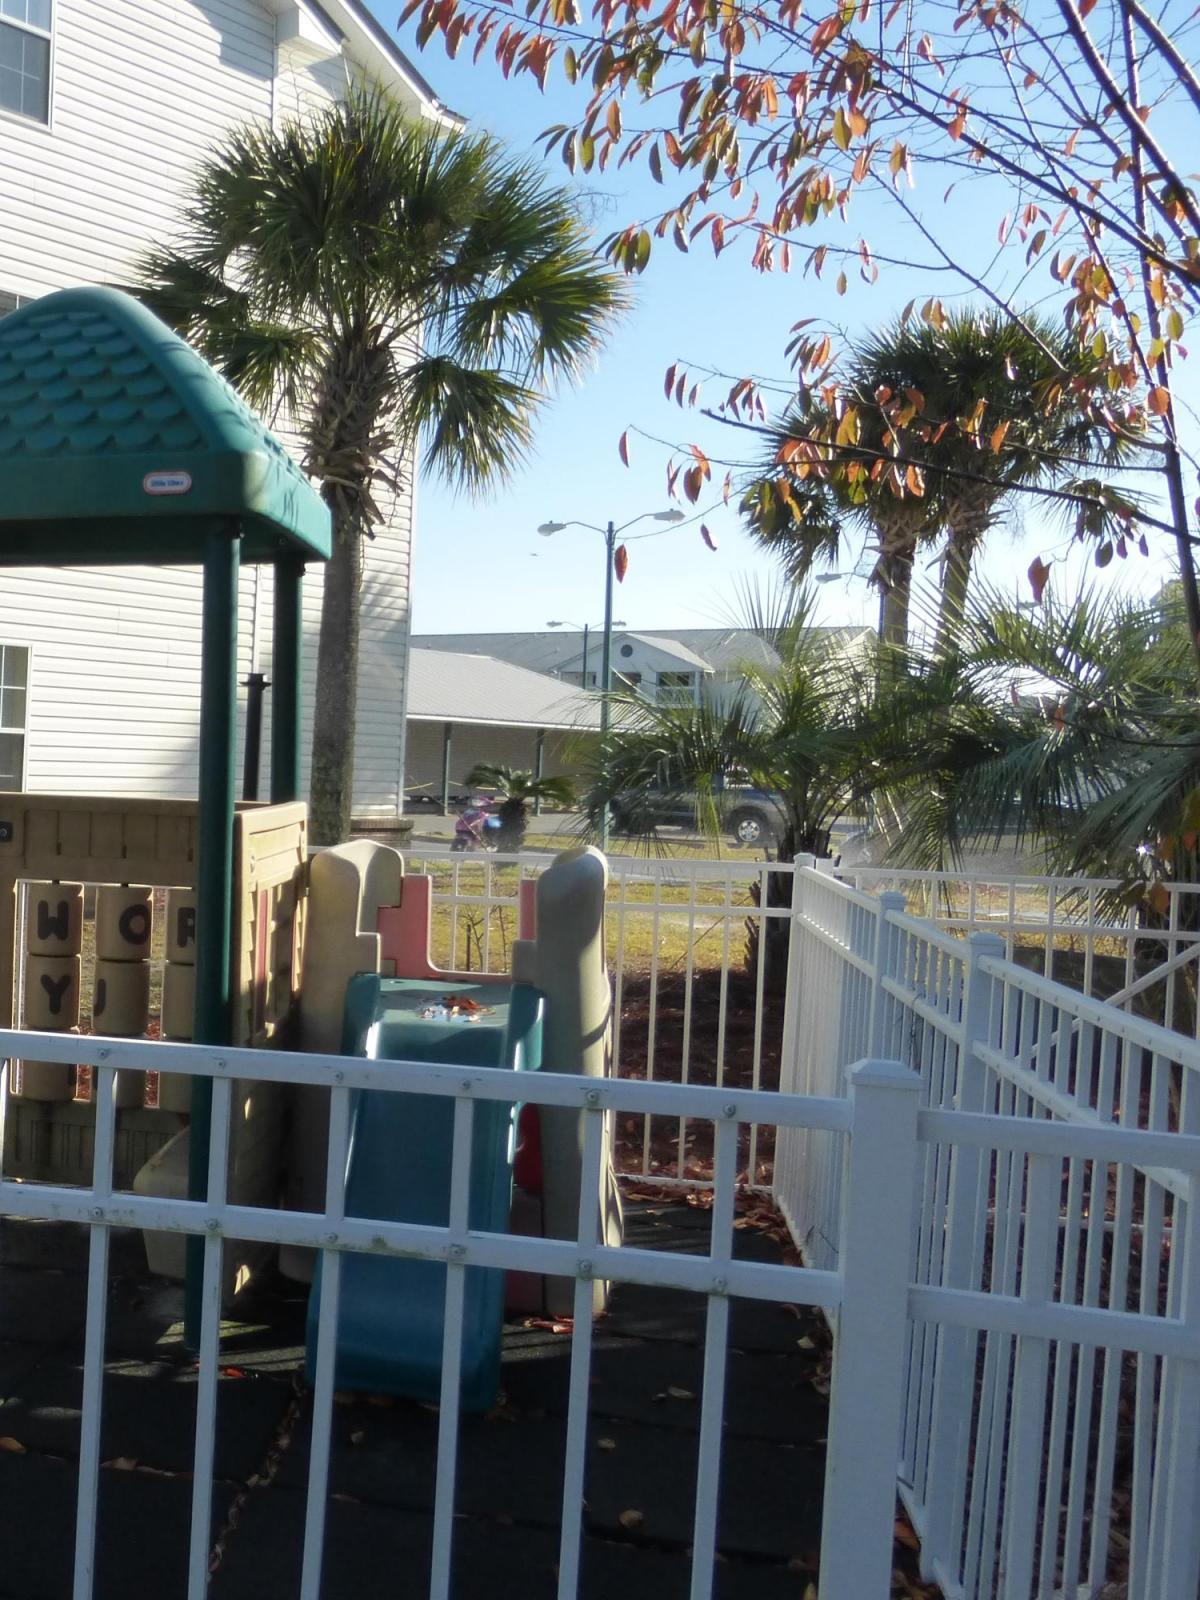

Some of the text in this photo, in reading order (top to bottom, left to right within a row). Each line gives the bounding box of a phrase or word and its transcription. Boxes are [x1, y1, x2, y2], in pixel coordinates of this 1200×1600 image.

[37, 900, 69, 941] W
[118, 904, 151, 945] O
[40, 974, 71, 1015] Y
